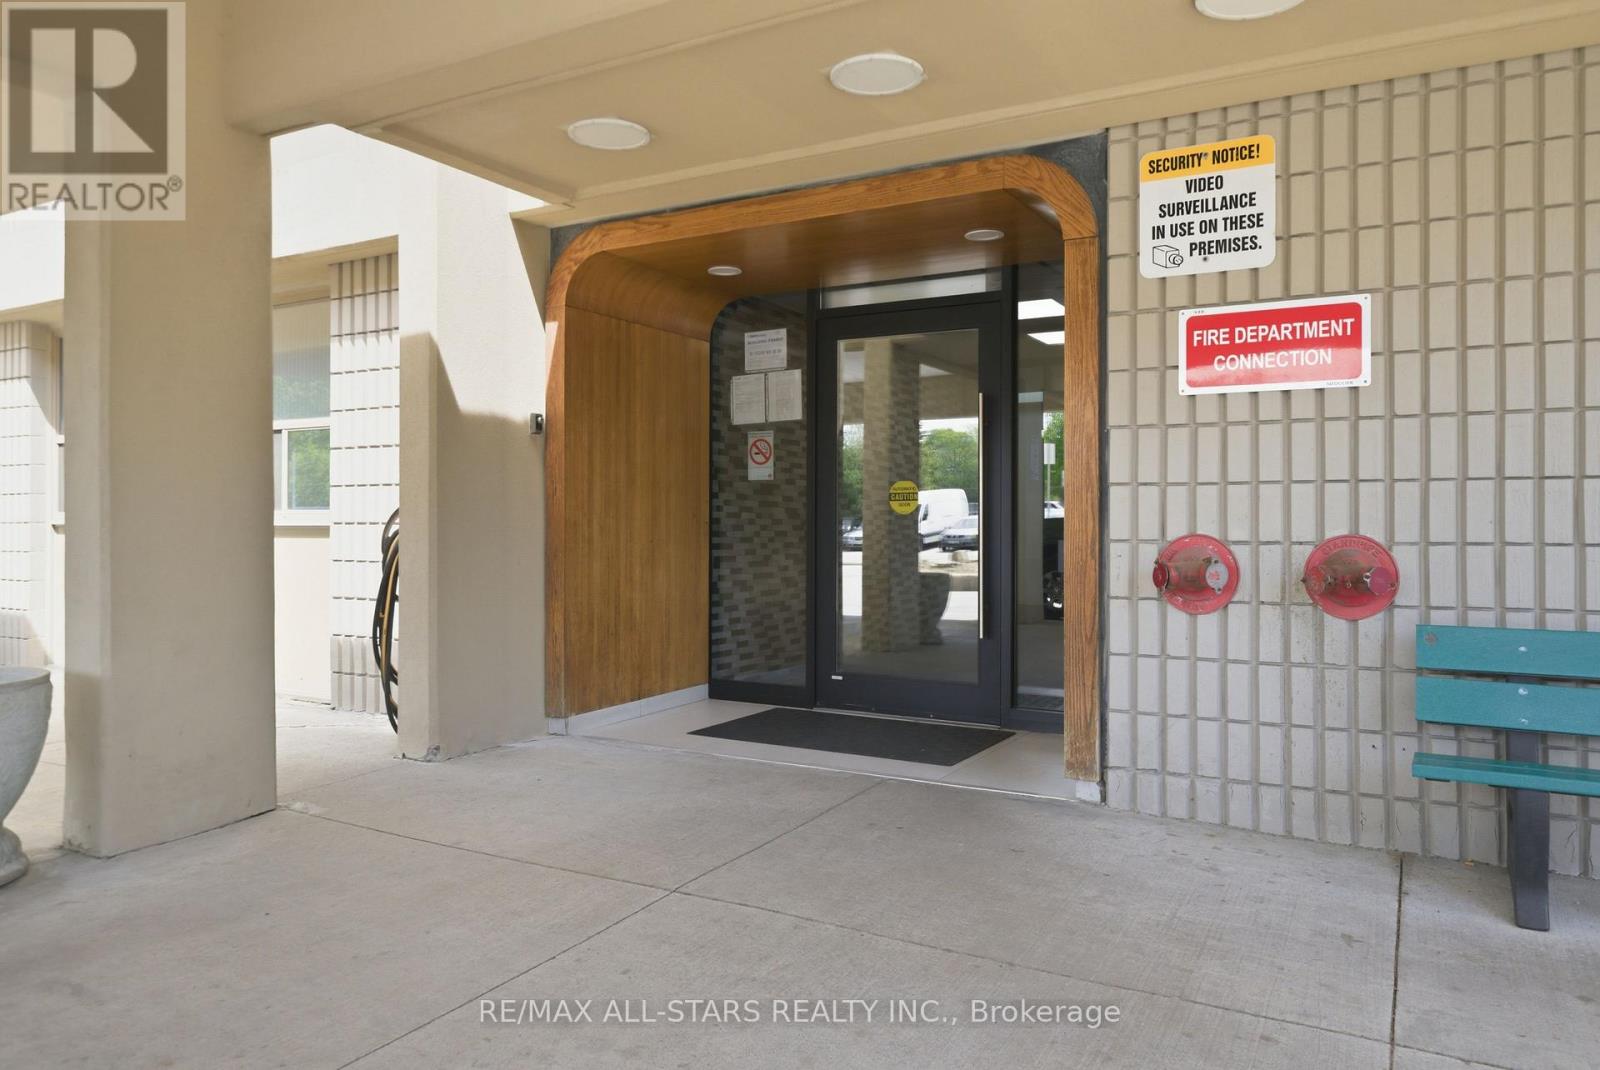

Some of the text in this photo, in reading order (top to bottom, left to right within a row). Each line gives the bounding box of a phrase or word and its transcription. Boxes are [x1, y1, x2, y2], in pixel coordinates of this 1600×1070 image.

[1148, 143, 1261, 175] SECURITY NOTICE!
[1185, 174, 1224, 194] VIDEO
[1158, 191, 1257, 219] SURVEILLANCE
[1151, 212, 1264, 241] IN USE ON THESE
[1189, 235, 1263, 257] PREMISES.
[1193, 318, 1355, 347] FIRE DEPARTMENT
[1213, 348, 1333, 372] CONNECTION
[890, 493, 918, 501] CAUTION
